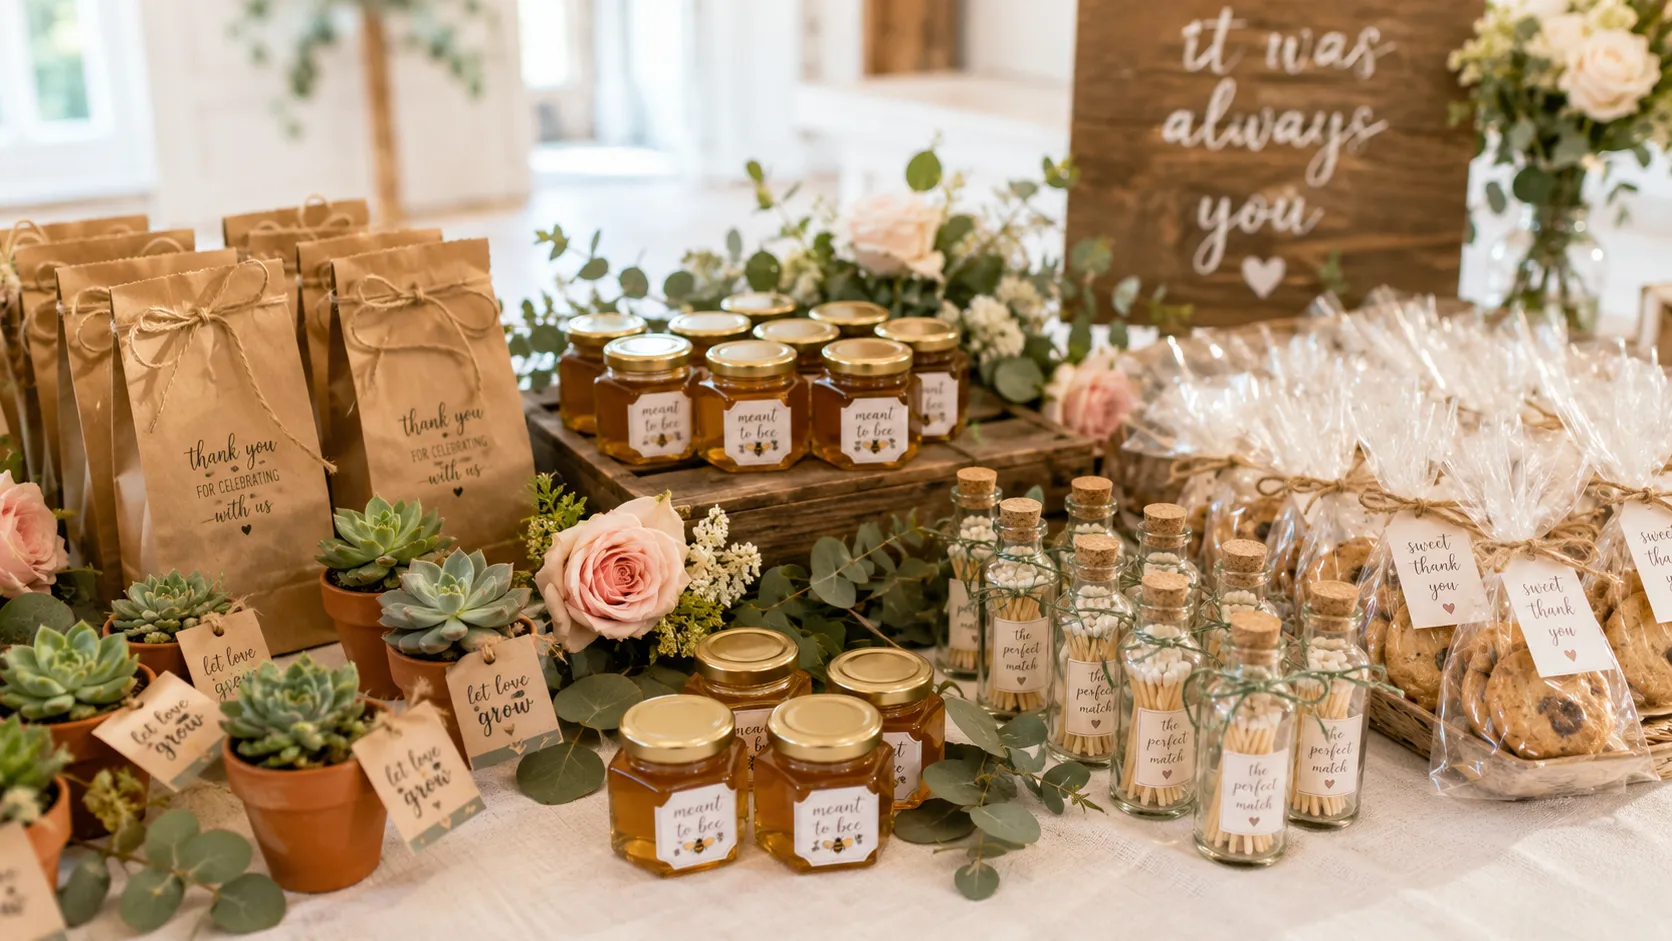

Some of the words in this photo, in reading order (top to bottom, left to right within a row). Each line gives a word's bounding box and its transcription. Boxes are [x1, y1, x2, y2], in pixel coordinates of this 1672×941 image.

[1181, 6, 1248, 75] it
[1265, 26, 1397, 80] was
[1162, 77, 1389, 188] always
[1193, 194, 1325, 275] you
[642, 401, 681, 416] meant
[738, 408, 778, 423] meant
[855, 405, 897, 421] meant
[397, 402, 451, 436] thank
[455, 408, 484, 436] you
[645, 419, 657, 432] to
[661, 416, 681, 430] bee
[739, 427, 752, 440] to
[756, 424, 778, 438] bee
[856, 423, 869, 437] to
[873, 423, 895, 437] bee
[184, 433, 240, 471] thank
[246, 440, 278, 471] you
[411, 448, 430, 463] FOR
[430, 435, 488, 459] CELEBRATING
[418, 459, 462, 485] with
[465, 464, 485, 478] us
[196, 483, 216, 499] FOR
[218, 468, 281, 494] CELEBRATING
[202, 494, 251, 523] with
[255, 500, 275, 514] us
[1407, 533, 1452, 552] sweet
[1640, 524, 1672, 544] swee
[1409, 554, 1462, 576] thank
[1644, 546, 1672, 566] tha
[1428, 581, 1460, 601] you
[1522, 575, 1565, 596] sweet
[1526, 596, 1577, 620] thank
[1012, 628, 1032, 641] the
[1548, 625, 1577, 646] you
[1003, 641, 1041, 659] perfect
[203, 654, 225, 676] let
[226, 646, 256, 667] love
[1006, 659, 1039, 671] match
[467, 683, 492, 705] let
[495, 673, 531, 696] love
[1079, 700, 1114, 714] match
[131, 724, 158, 746] let
[154, 700, 190, 726] love
[478, 698, 534, 737] grow
[1161, 717, 1180, 731] the
[156, 714, 204, 761] grow
[1147, 732, 1188, 750] perfect
[1150, 749, 1186, 765] match
[1308, 743, 1353, 761] perfect
[385, 761, 408, 787] let
[408, 746, 443, 772] love
[1249, 762, 1269, 777] the
[1312, 760, 1349, 774] match
[403, 768, 453, 818] grow
[1232, 778, 1278, 797] perfect
[673, 794, 724, 819] meant
[812, 796, 866, 816] meant
[1235, 797, 1273, 811] match
[675, 823, 692, 839] to
[698, 817, 726, 834] bee
[813, 821, 830, 837] to
[836, 816, 864, 834] bee
